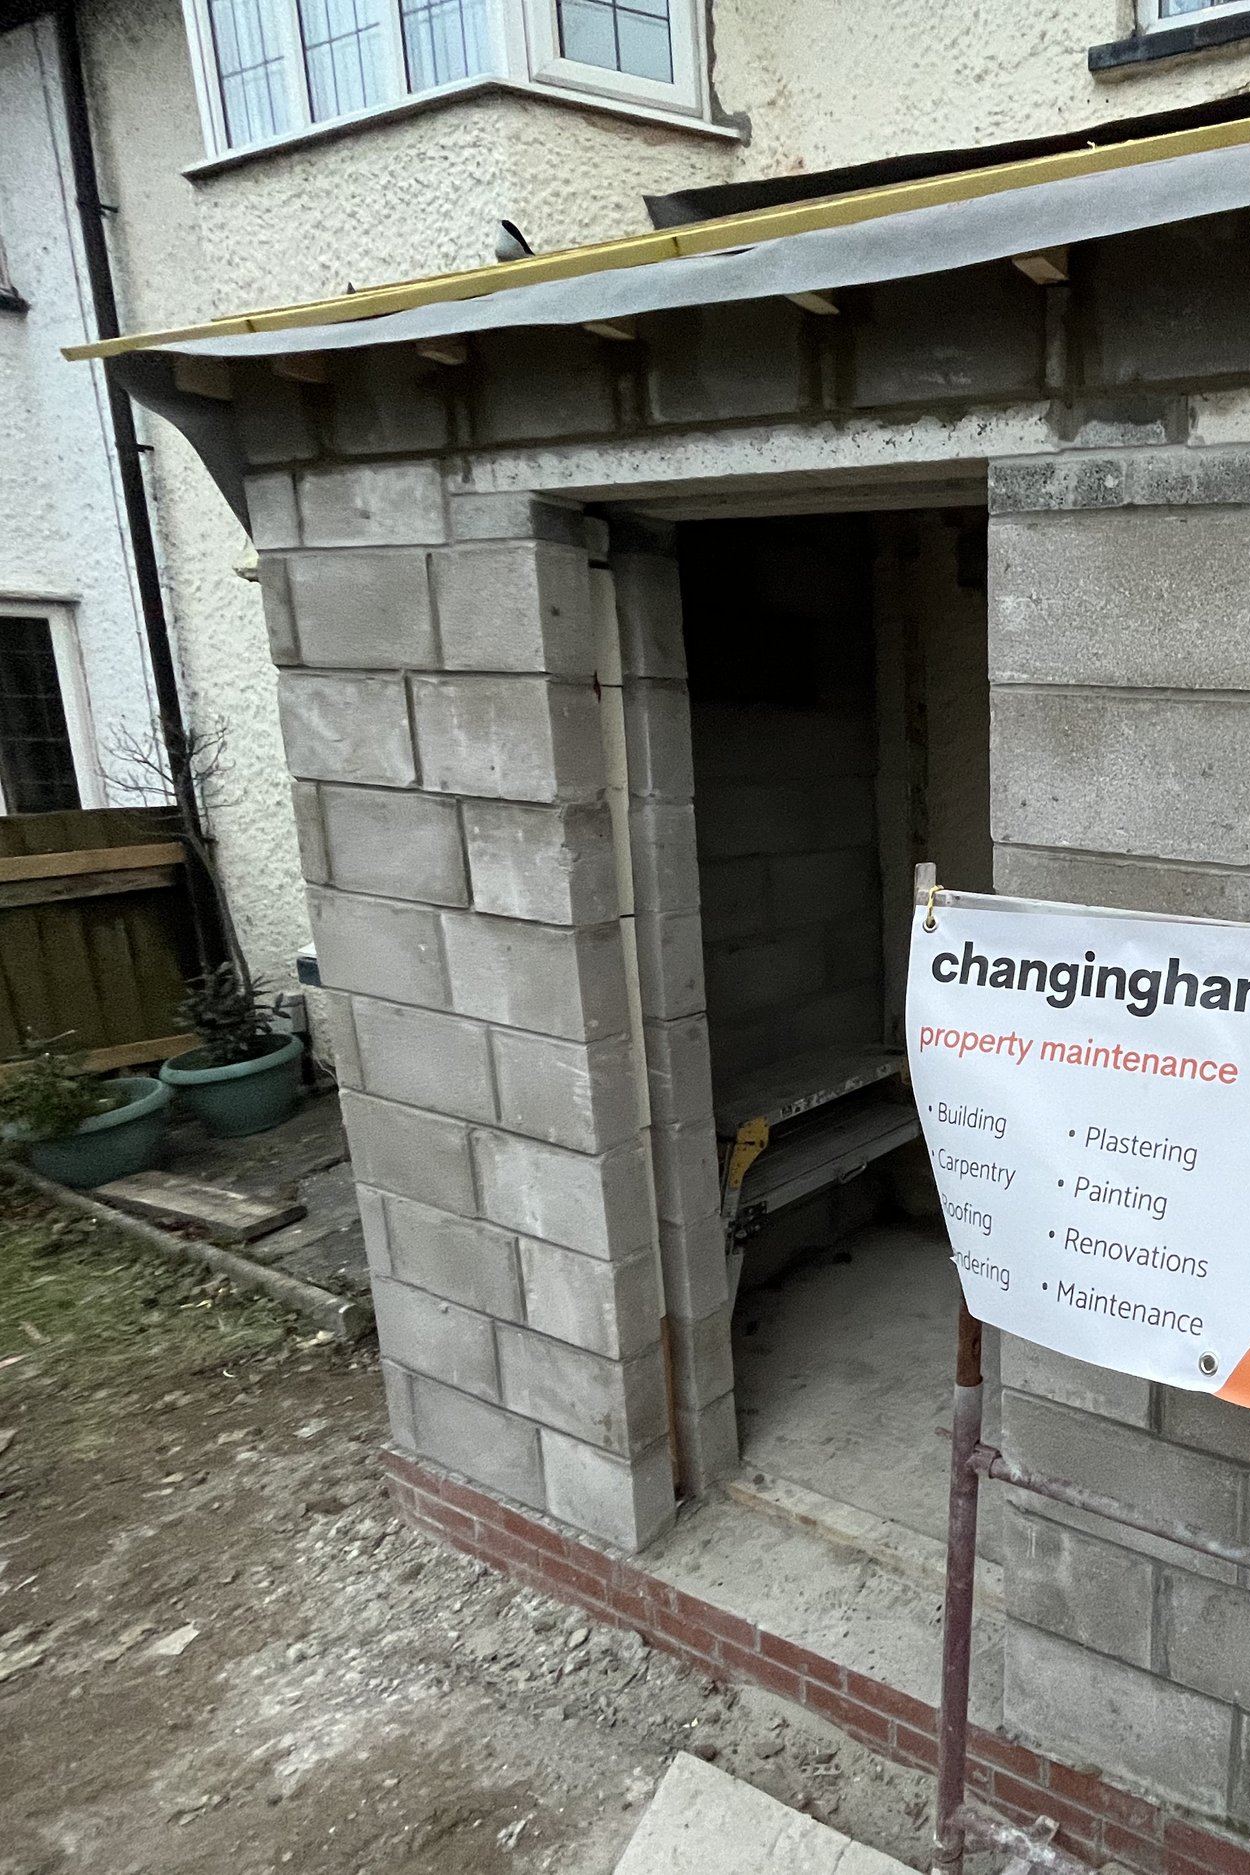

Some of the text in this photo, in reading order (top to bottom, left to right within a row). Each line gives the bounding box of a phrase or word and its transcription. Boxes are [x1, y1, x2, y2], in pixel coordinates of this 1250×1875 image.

[919, 1026, 1239, 1084] property maintenance
[937, 1103, 1008, 1139] Building
[937, 1149, 1017, 1190] Carpentry
[1085, 1127, 1198, 1171] Plastering
[1074, 1176, 1168, 1220] Painting
[952, 1248, 1010, 1291] ndering
[1064, 1228, 1209, 1278] Renovations
[1056, 1281, 1204, 1336] Maintenance
